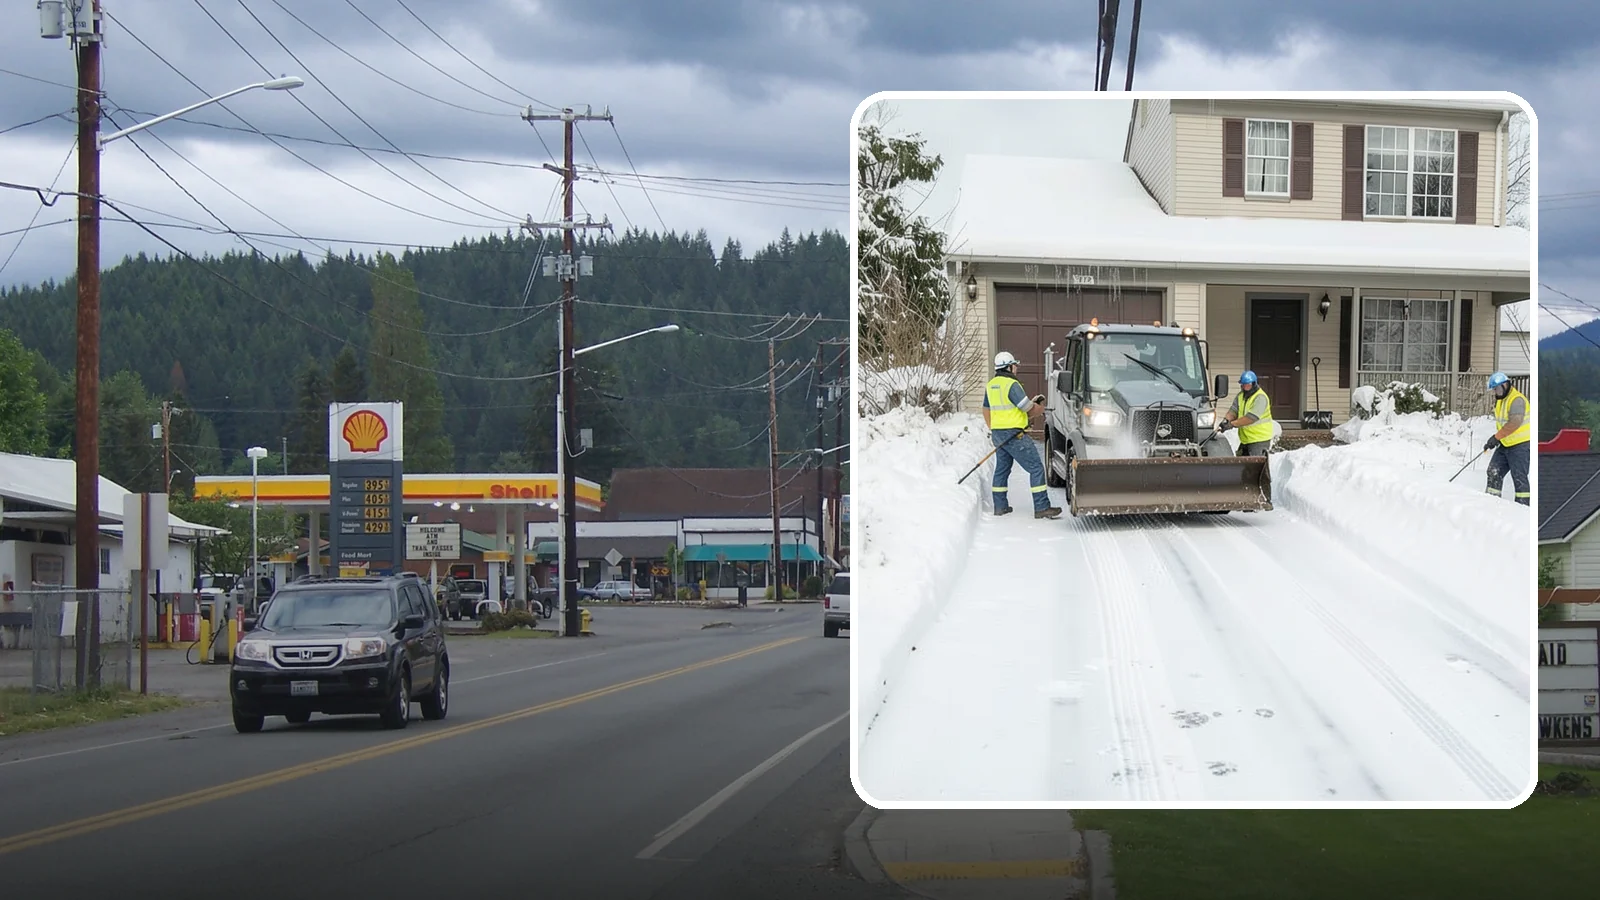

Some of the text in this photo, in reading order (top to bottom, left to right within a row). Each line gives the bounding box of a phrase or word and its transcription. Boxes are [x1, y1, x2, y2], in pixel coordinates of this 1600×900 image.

[366, 480, 383, 490] 395
[490, 484, 547, 499] Shell
[366, 494, 383, 504] 405
[366, 508, 383, 518] 415
[366, 522, 383, 532] 429
